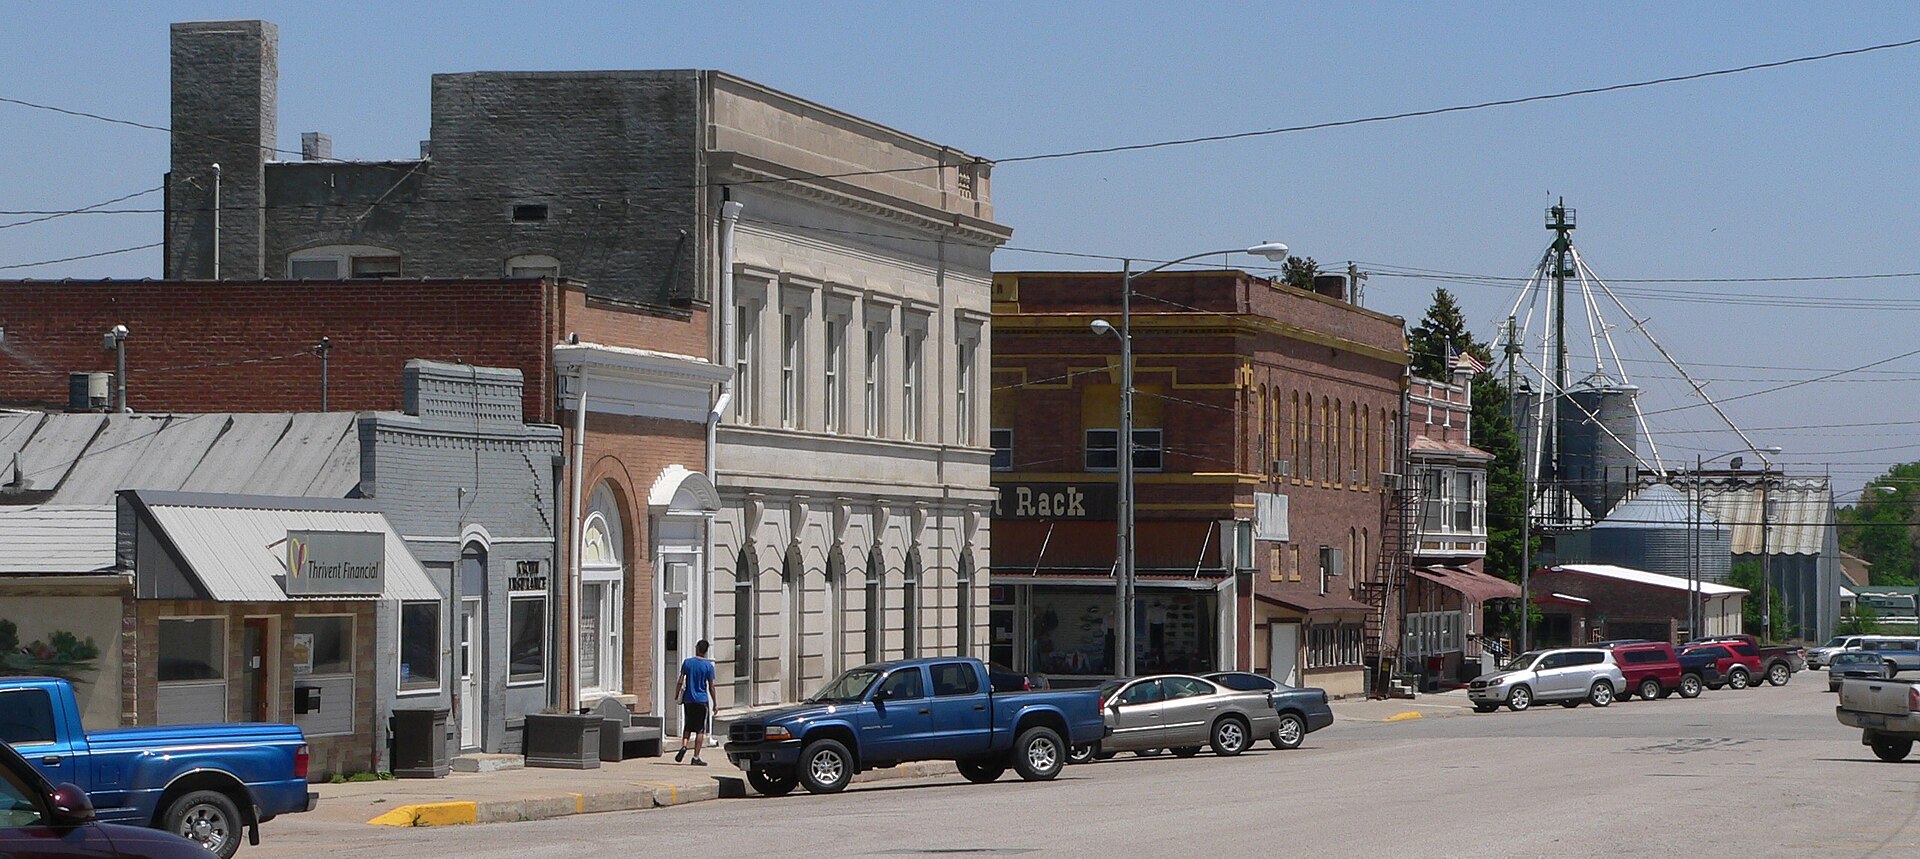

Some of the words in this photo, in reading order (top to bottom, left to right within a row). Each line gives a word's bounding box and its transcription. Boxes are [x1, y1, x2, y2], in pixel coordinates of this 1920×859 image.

[1016, 486, 1086, 516] Rack
[308, 560, 341, 579] Thrivent
[343, 562, 379, 579] Financial
